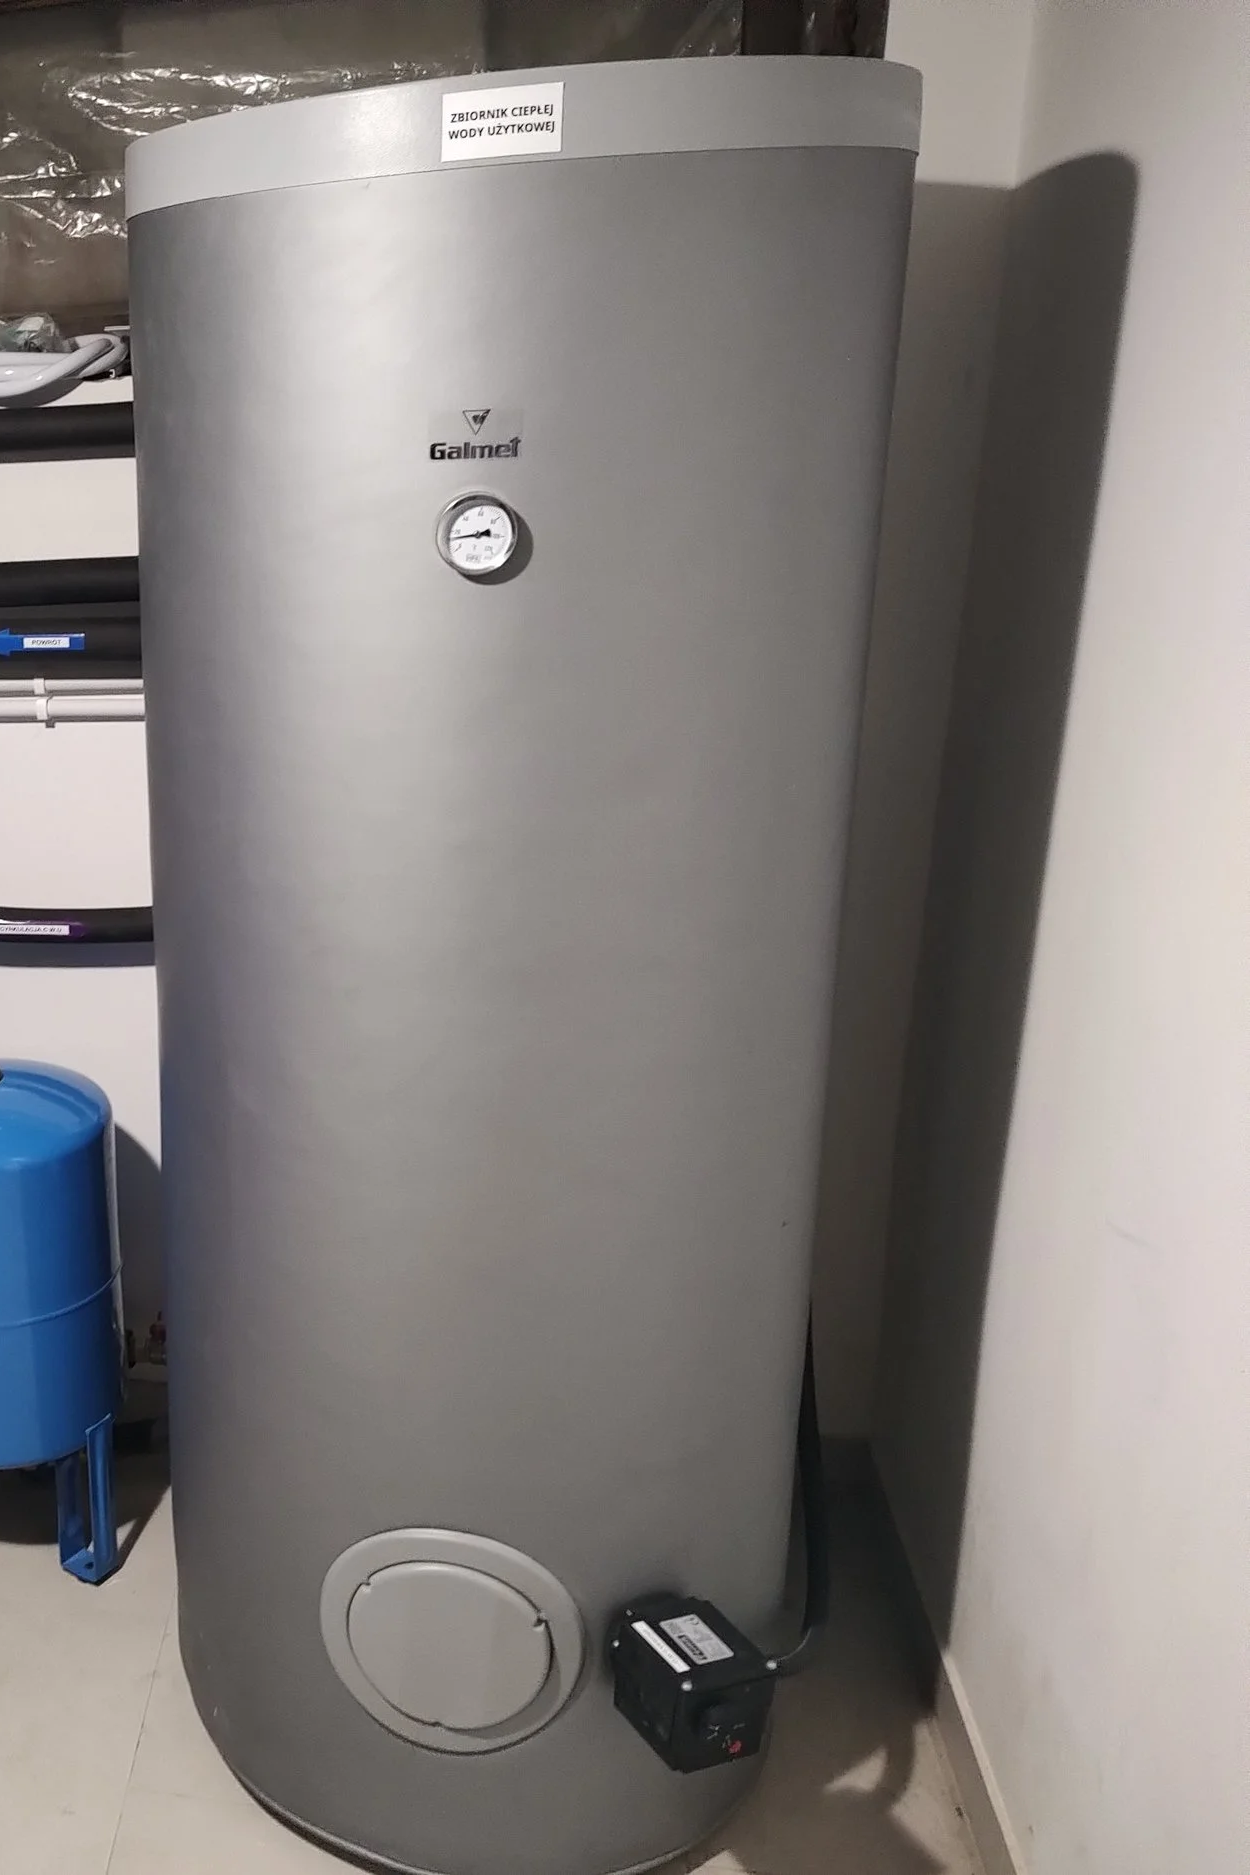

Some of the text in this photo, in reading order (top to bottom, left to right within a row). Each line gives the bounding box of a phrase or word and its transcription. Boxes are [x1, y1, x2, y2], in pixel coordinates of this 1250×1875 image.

[450, 104, 554, 123] ZBIORNIK CIEPŁEJ
[448, 121, 555, 140] WODY UŻYTKOWEJ
[430, 436, 522, 460] Galmet
